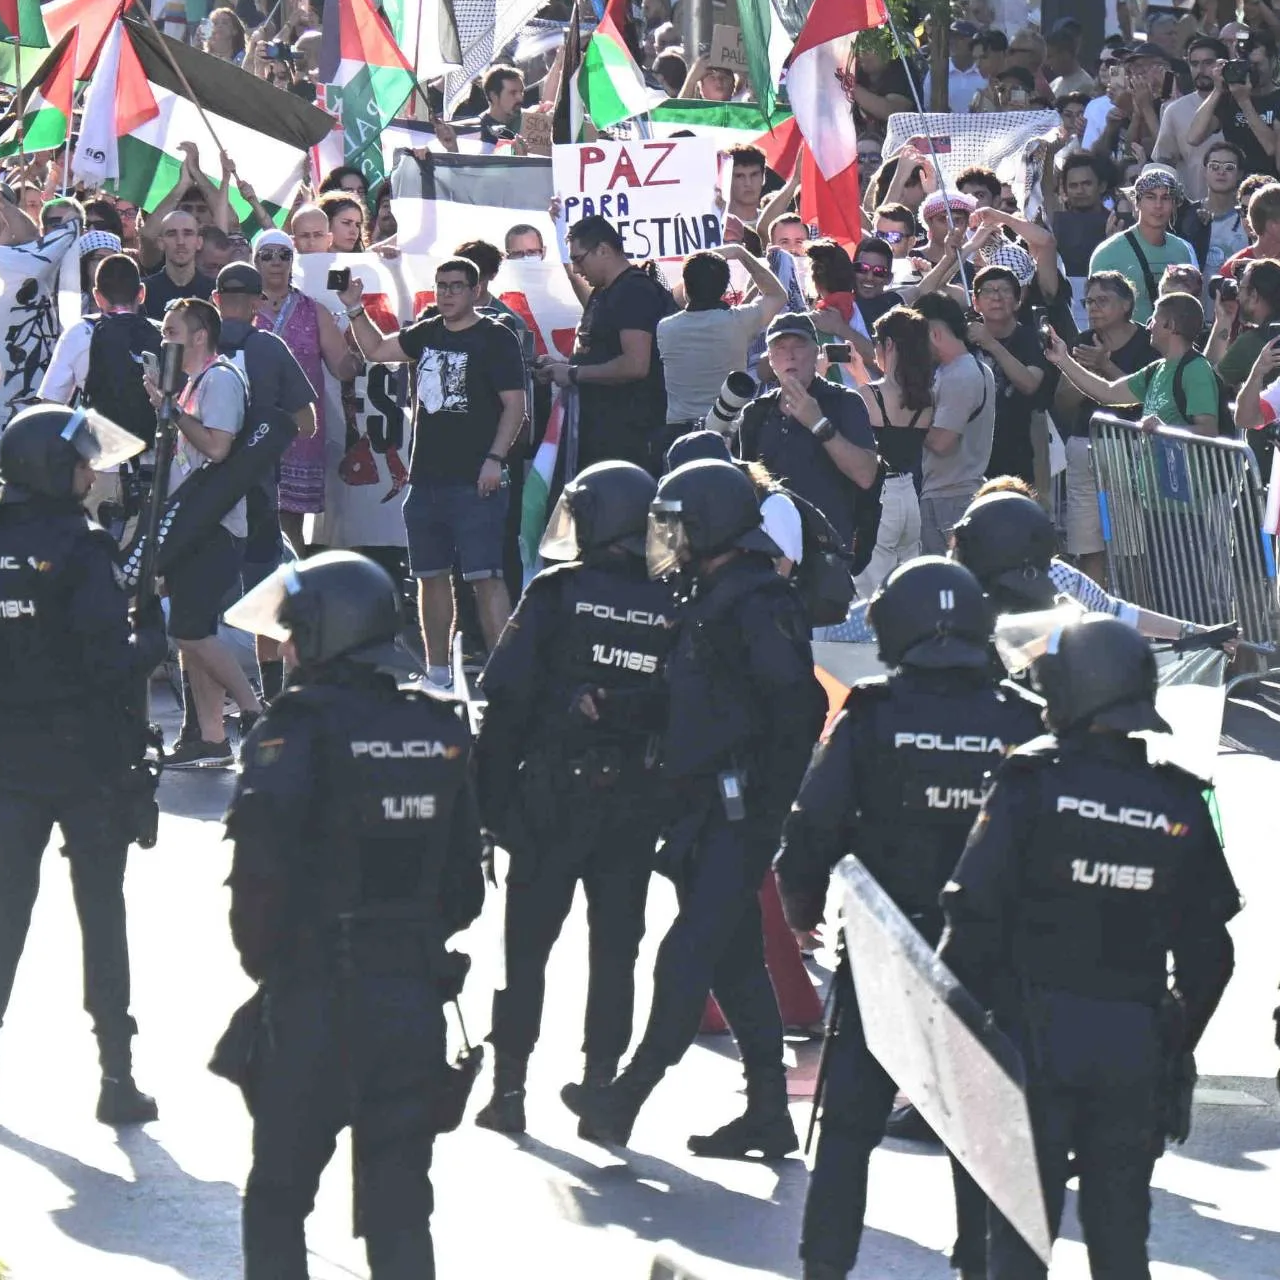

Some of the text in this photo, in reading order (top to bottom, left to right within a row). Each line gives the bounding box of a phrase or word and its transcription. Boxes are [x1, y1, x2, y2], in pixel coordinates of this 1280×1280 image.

[579, 143, 680, 192] PAZ
[564, 193, 629, 222] PARA
[575, 601, 666, 626] POLICIA
[592, 643, 658, 674] 1U1185
[350, 740, 448, 758] POLICIA
[894, 732, 1004, 754] POLICIA
[1057, 795, 1170, 834] POLICIA
